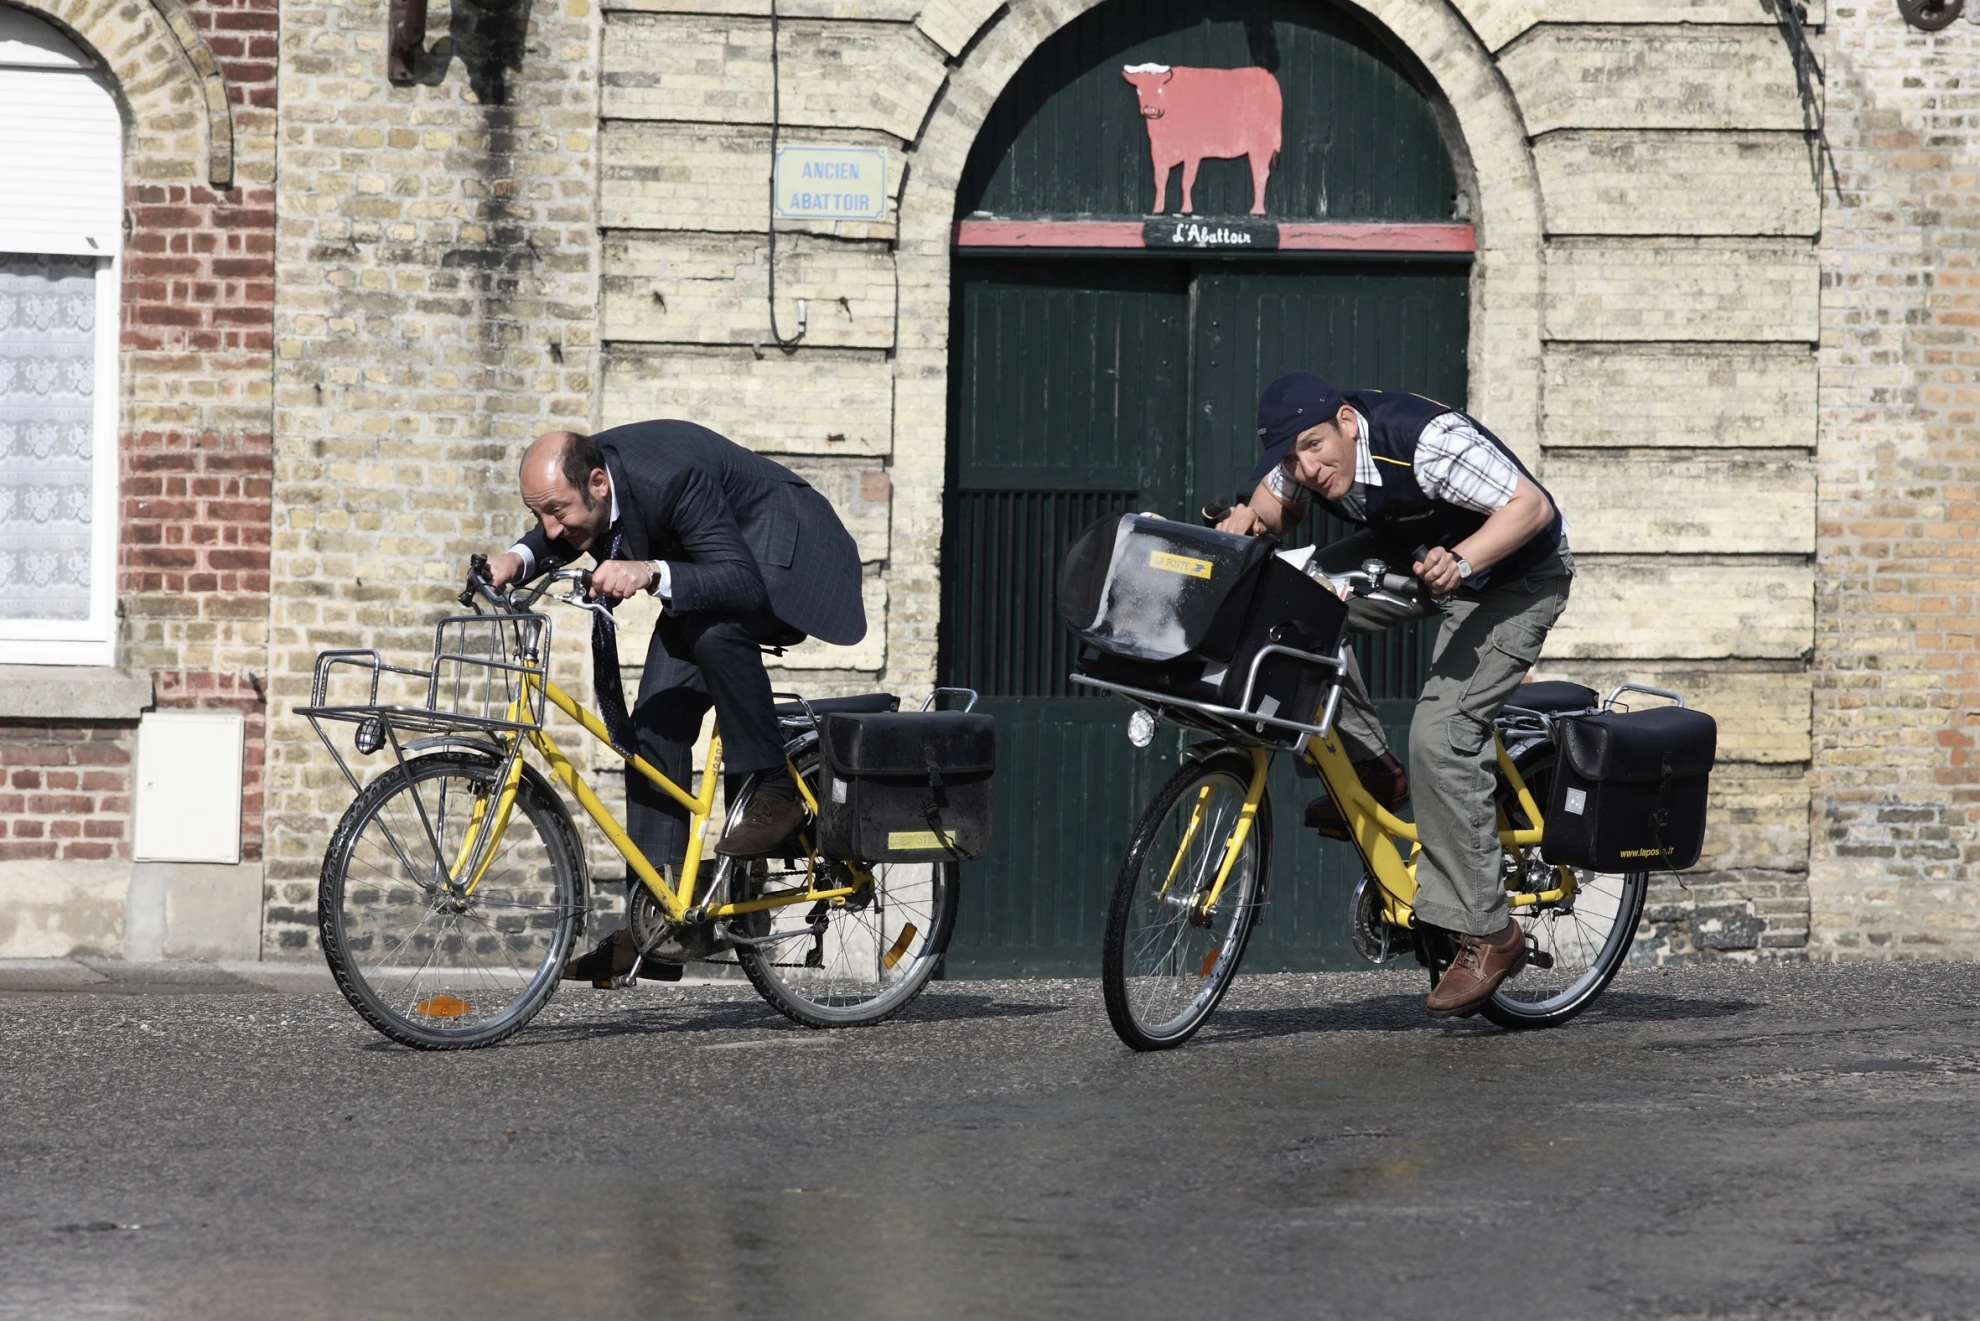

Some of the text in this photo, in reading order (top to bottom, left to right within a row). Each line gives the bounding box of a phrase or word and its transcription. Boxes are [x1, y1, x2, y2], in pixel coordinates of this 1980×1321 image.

[802, 161, 860, 179] ANCIEN
[790, 192, 870, 211] ABATTOIR
[1620, 846, 1674, 858] www.lapose.fr
